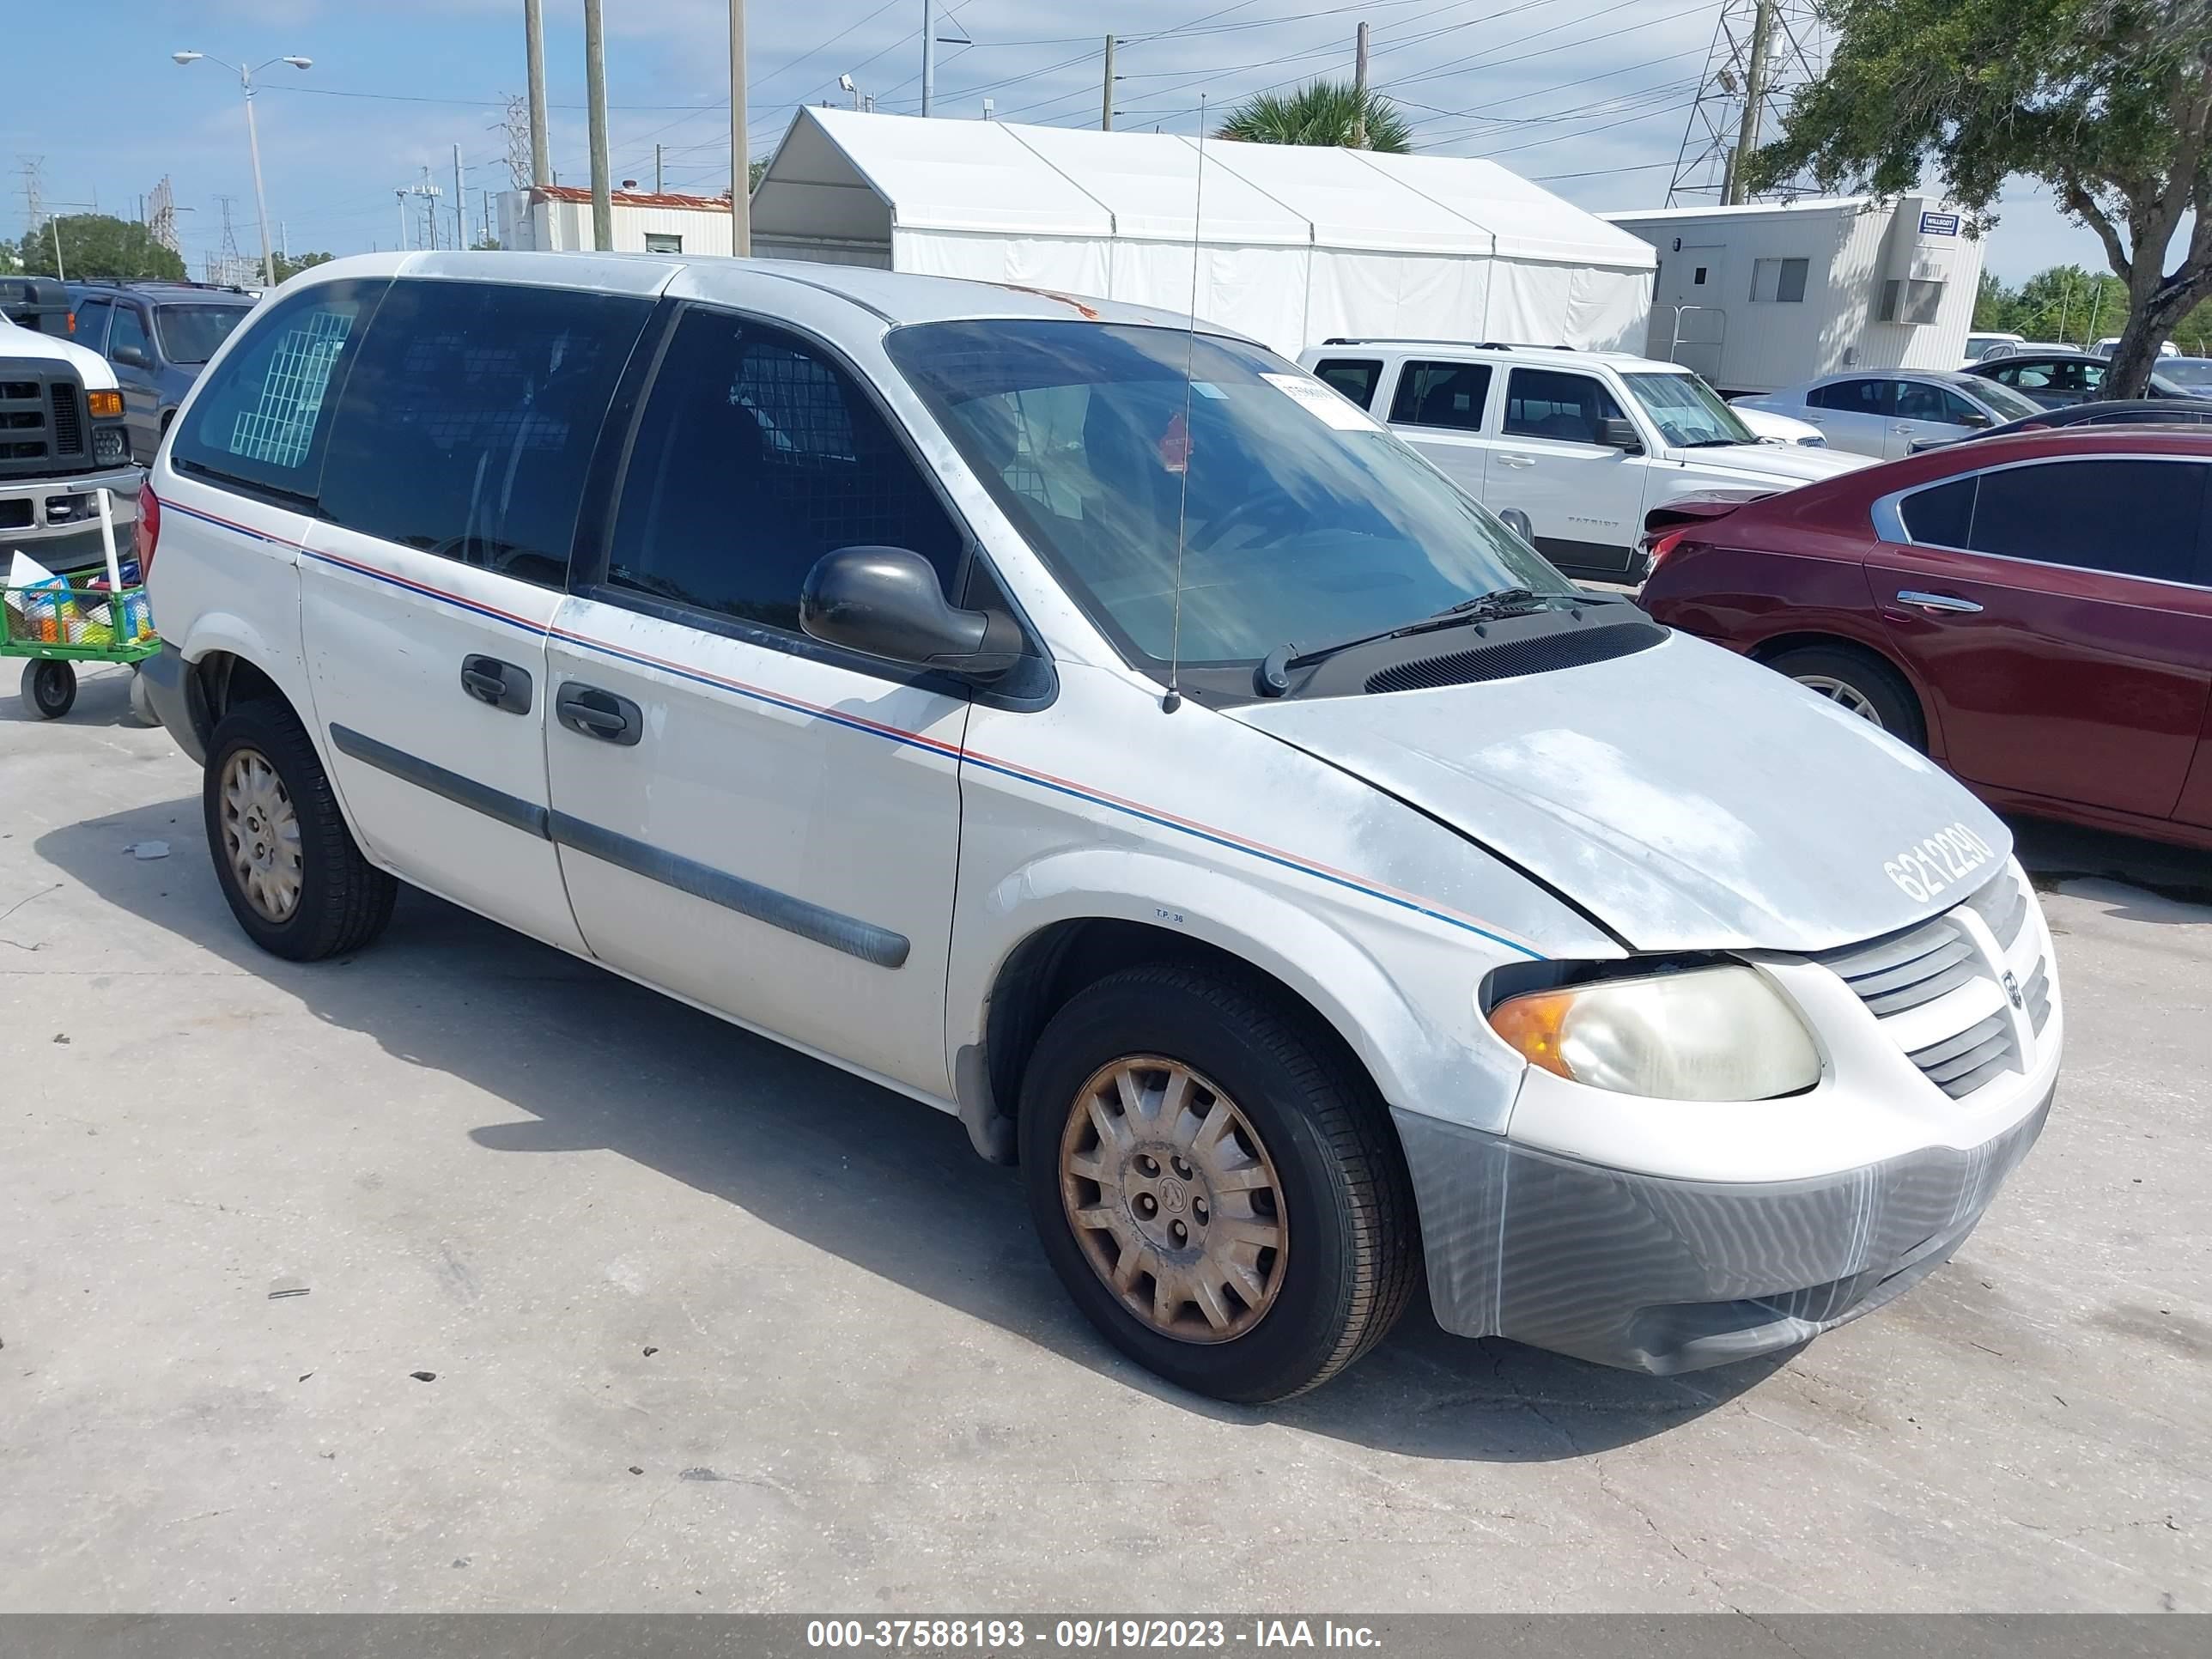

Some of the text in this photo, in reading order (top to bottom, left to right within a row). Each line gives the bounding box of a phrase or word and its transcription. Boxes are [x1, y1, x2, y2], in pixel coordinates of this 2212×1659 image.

[1927, 217, 1954, 227] WILLSCOT
[1567, 516, 1620, 527] PATRIOT
[1883, 822, 1995, 902] 6212290
[1174, 914, 1184, 923] 36
